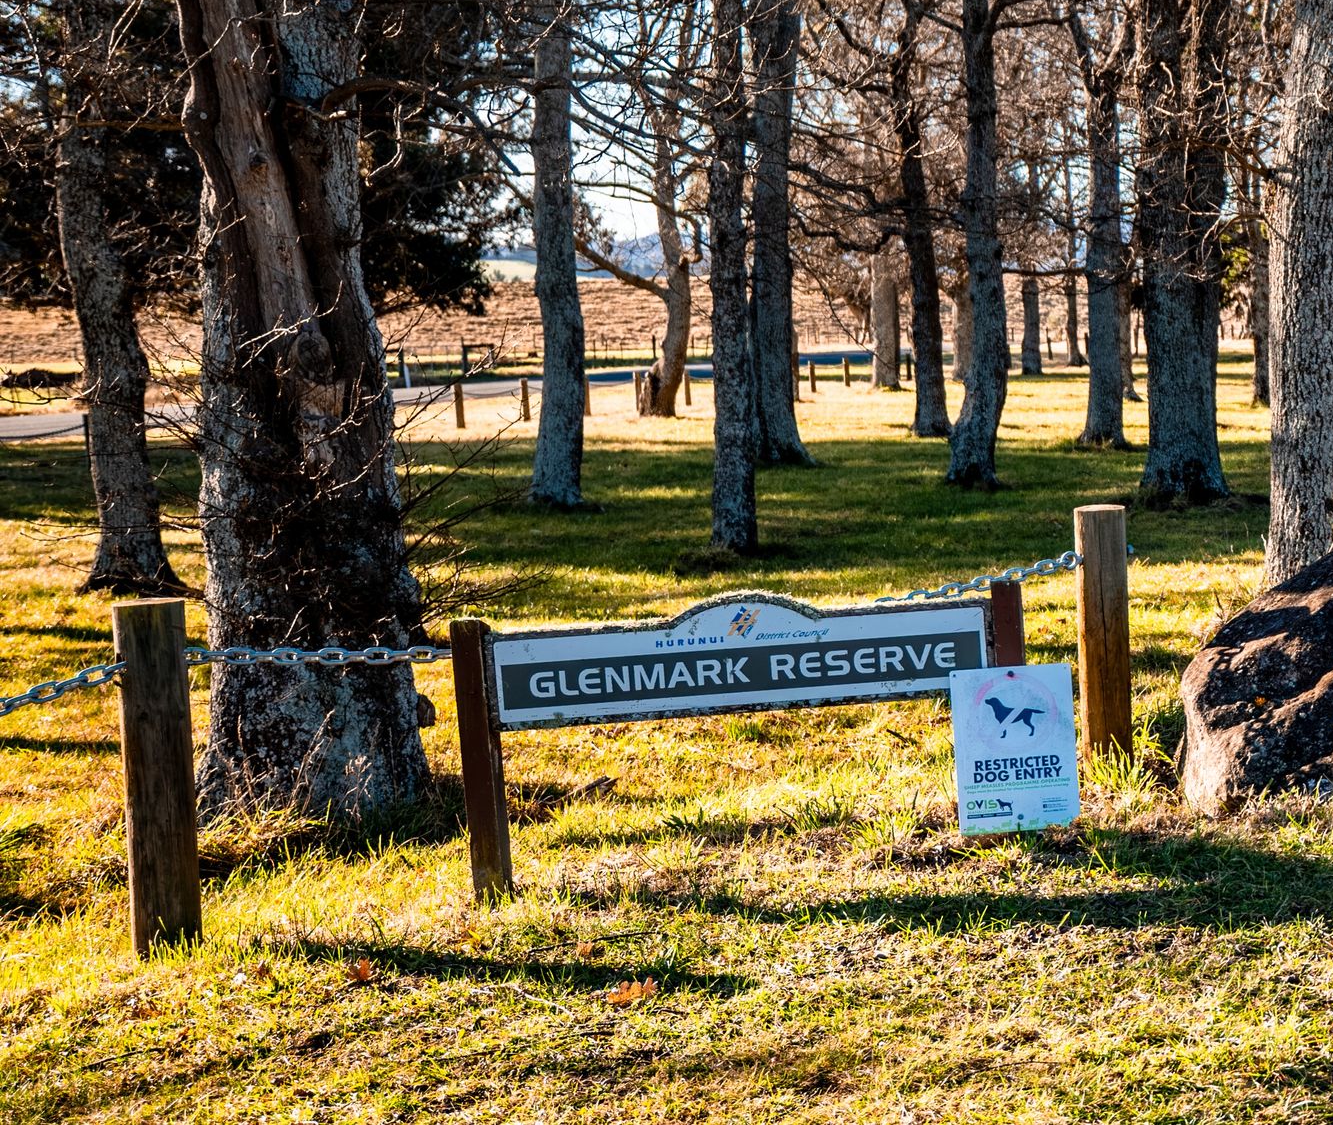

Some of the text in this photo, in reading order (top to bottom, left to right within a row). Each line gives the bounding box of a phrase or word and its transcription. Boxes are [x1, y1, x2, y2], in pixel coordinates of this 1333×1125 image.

[656, 628, 830, 648] HURUNUI District Council
[529, 641, 956, 698] GLENMARK RESERVE
[974, 755, 1060, 772] RESTRICTED
[973, 766, 1063, 784] DOG ENTRY
[966, 799, 998, 810] OVIS
